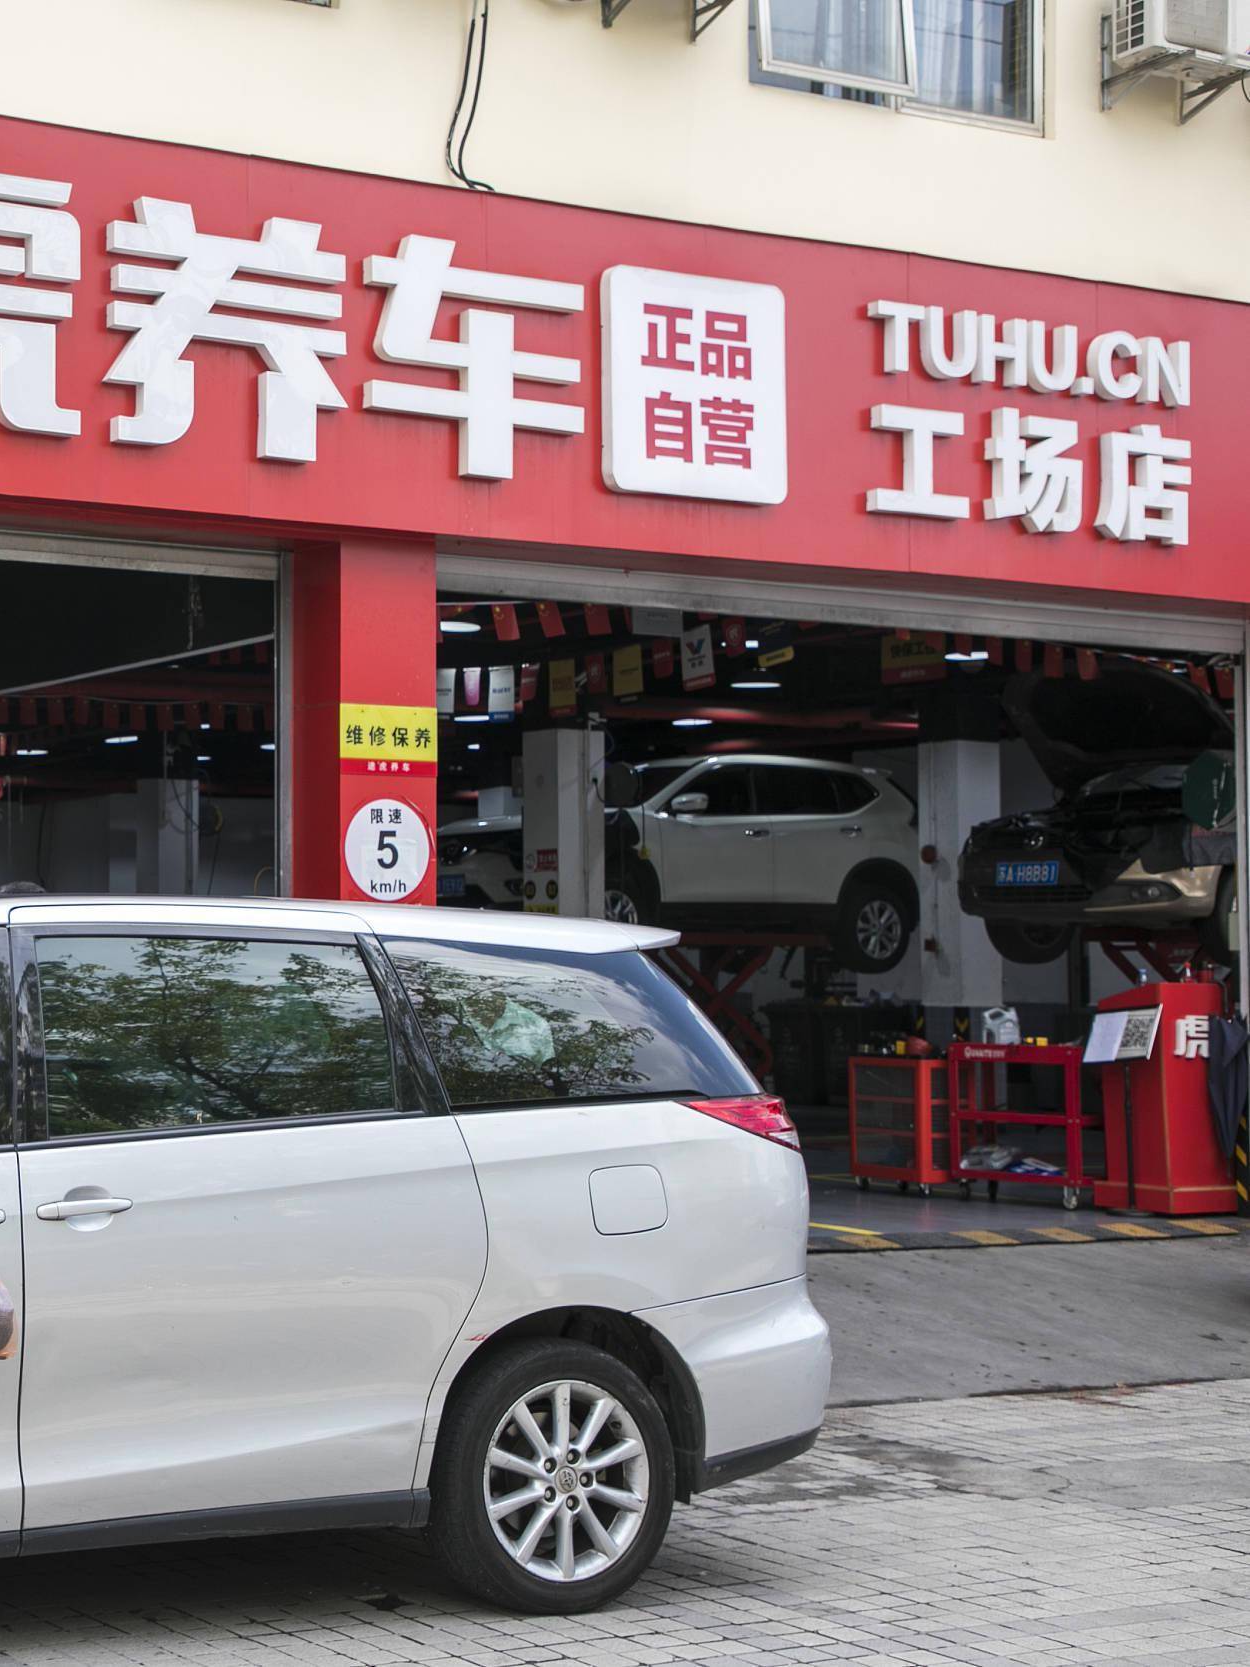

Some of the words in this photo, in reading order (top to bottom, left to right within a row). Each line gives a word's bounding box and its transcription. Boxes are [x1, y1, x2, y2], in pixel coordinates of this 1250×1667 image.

[641, 303, 753, 381] 正品
[867, 300, 1191, 407] TUHU.CN
[644, 390, 755, 470] 自营
[866, 404, 1192, 546] 工场店
[345, 724, 432, 749] 维修保养
[366, 760, 412, 773] 途虎养车
[370, 808, 402, 825] 限速
[376, 830, 399, 869] 5
[370, 879, 407, 894] km/h
[1174, 1014, 1210, 1059] 虎
